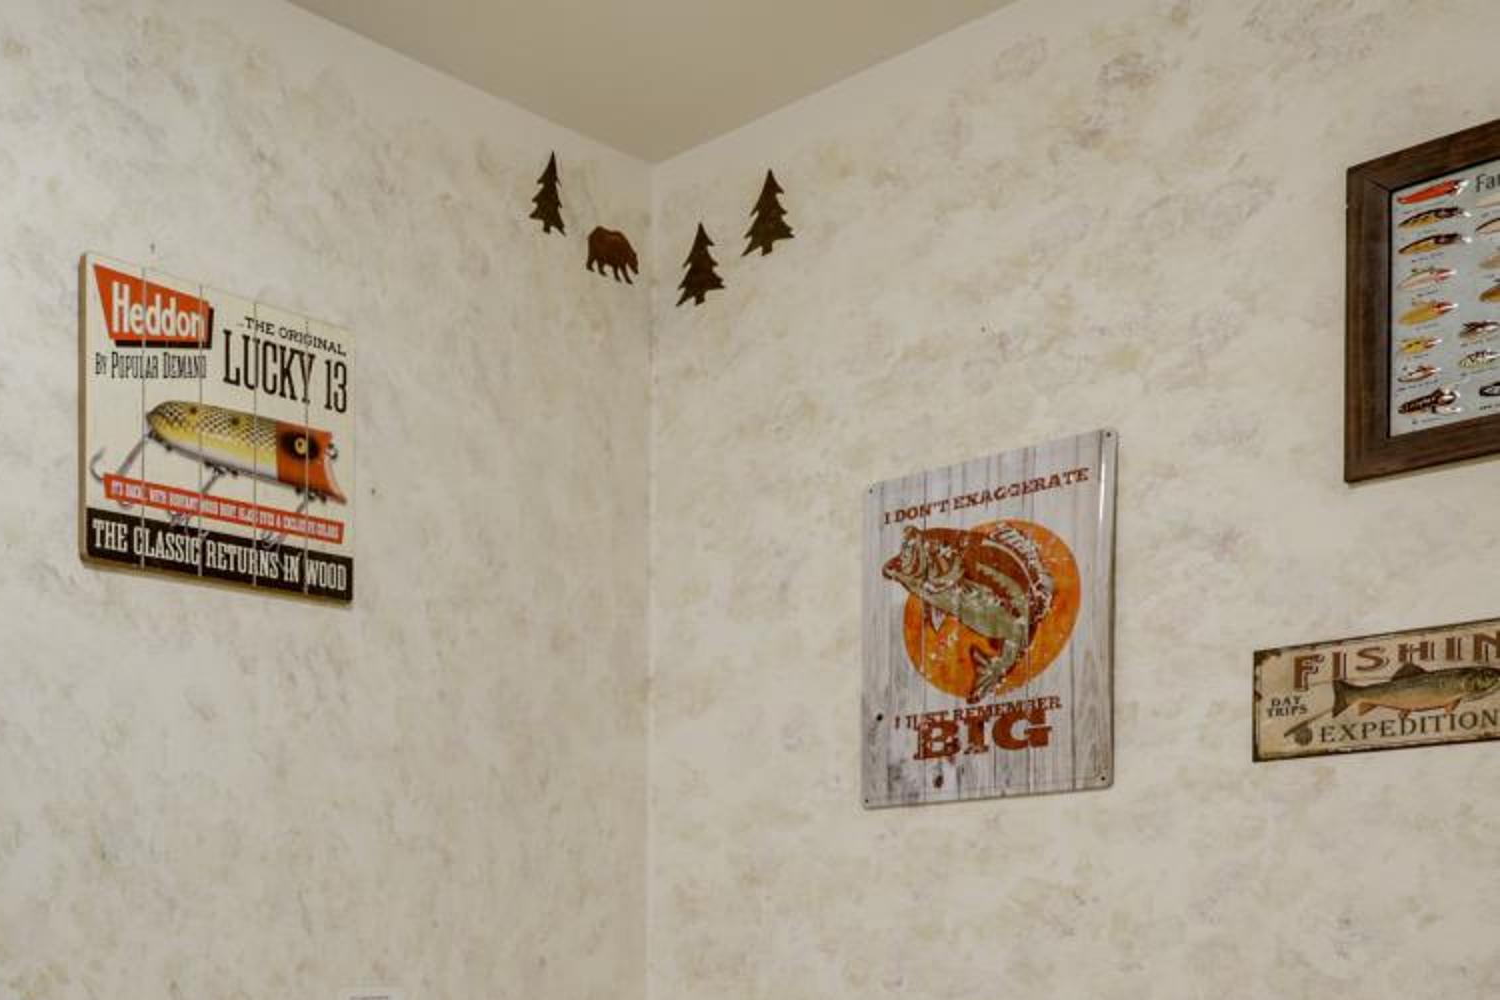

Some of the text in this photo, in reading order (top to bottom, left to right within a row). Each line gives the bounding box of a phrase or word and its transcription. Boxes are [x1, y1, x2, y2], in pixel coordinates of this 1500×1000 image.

[111, 281, 206, 338] Heddon
[244, 316, 347, 357] THE ORIGINAL
[223, 329, 347, 413] LUCKY 13
[884, 467, 1090, 525] I DON'T EXAGGERATE
[93, 518, 347, 591] THE CLASSIC RETURNS IN WOOD
[913, 704, 1053, 760] BIG
